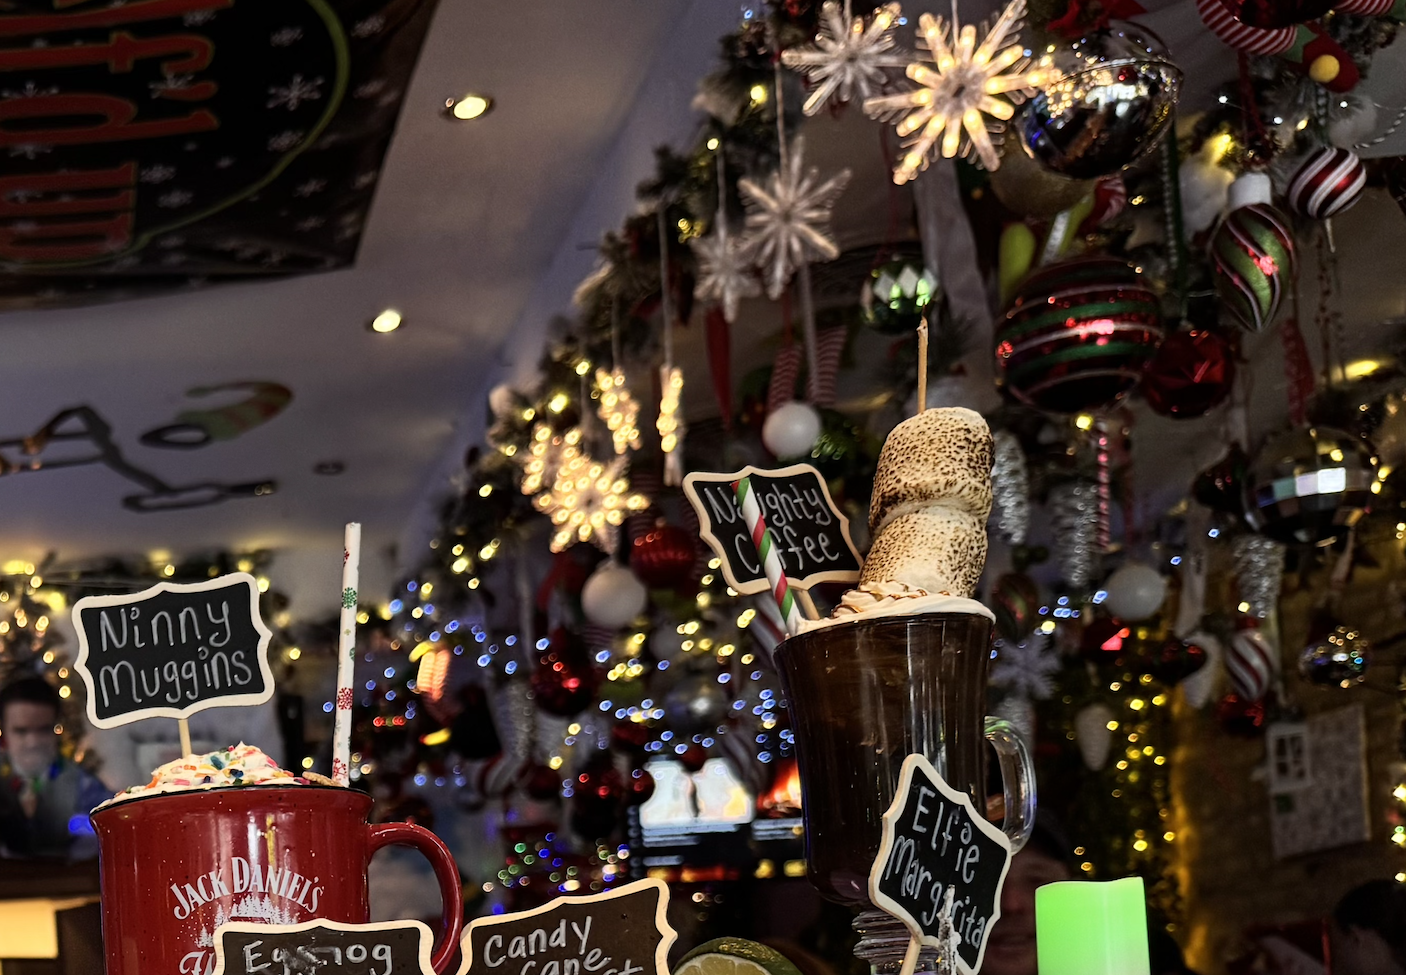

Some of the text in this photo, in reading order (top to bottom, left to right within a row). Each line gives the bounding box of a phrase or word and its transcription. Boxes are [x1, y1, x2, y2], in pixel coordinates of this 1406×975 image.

[734, 524, 840, 574] Cffee
[100, 601, 231, 652] Ninny
[99, 646, 252, 708] Muggins
[170, 857, 325, 920] JACK DANIEL'S
[885, 835, 985, 949] Margrita
[484, 915, 592, 967] Candy
